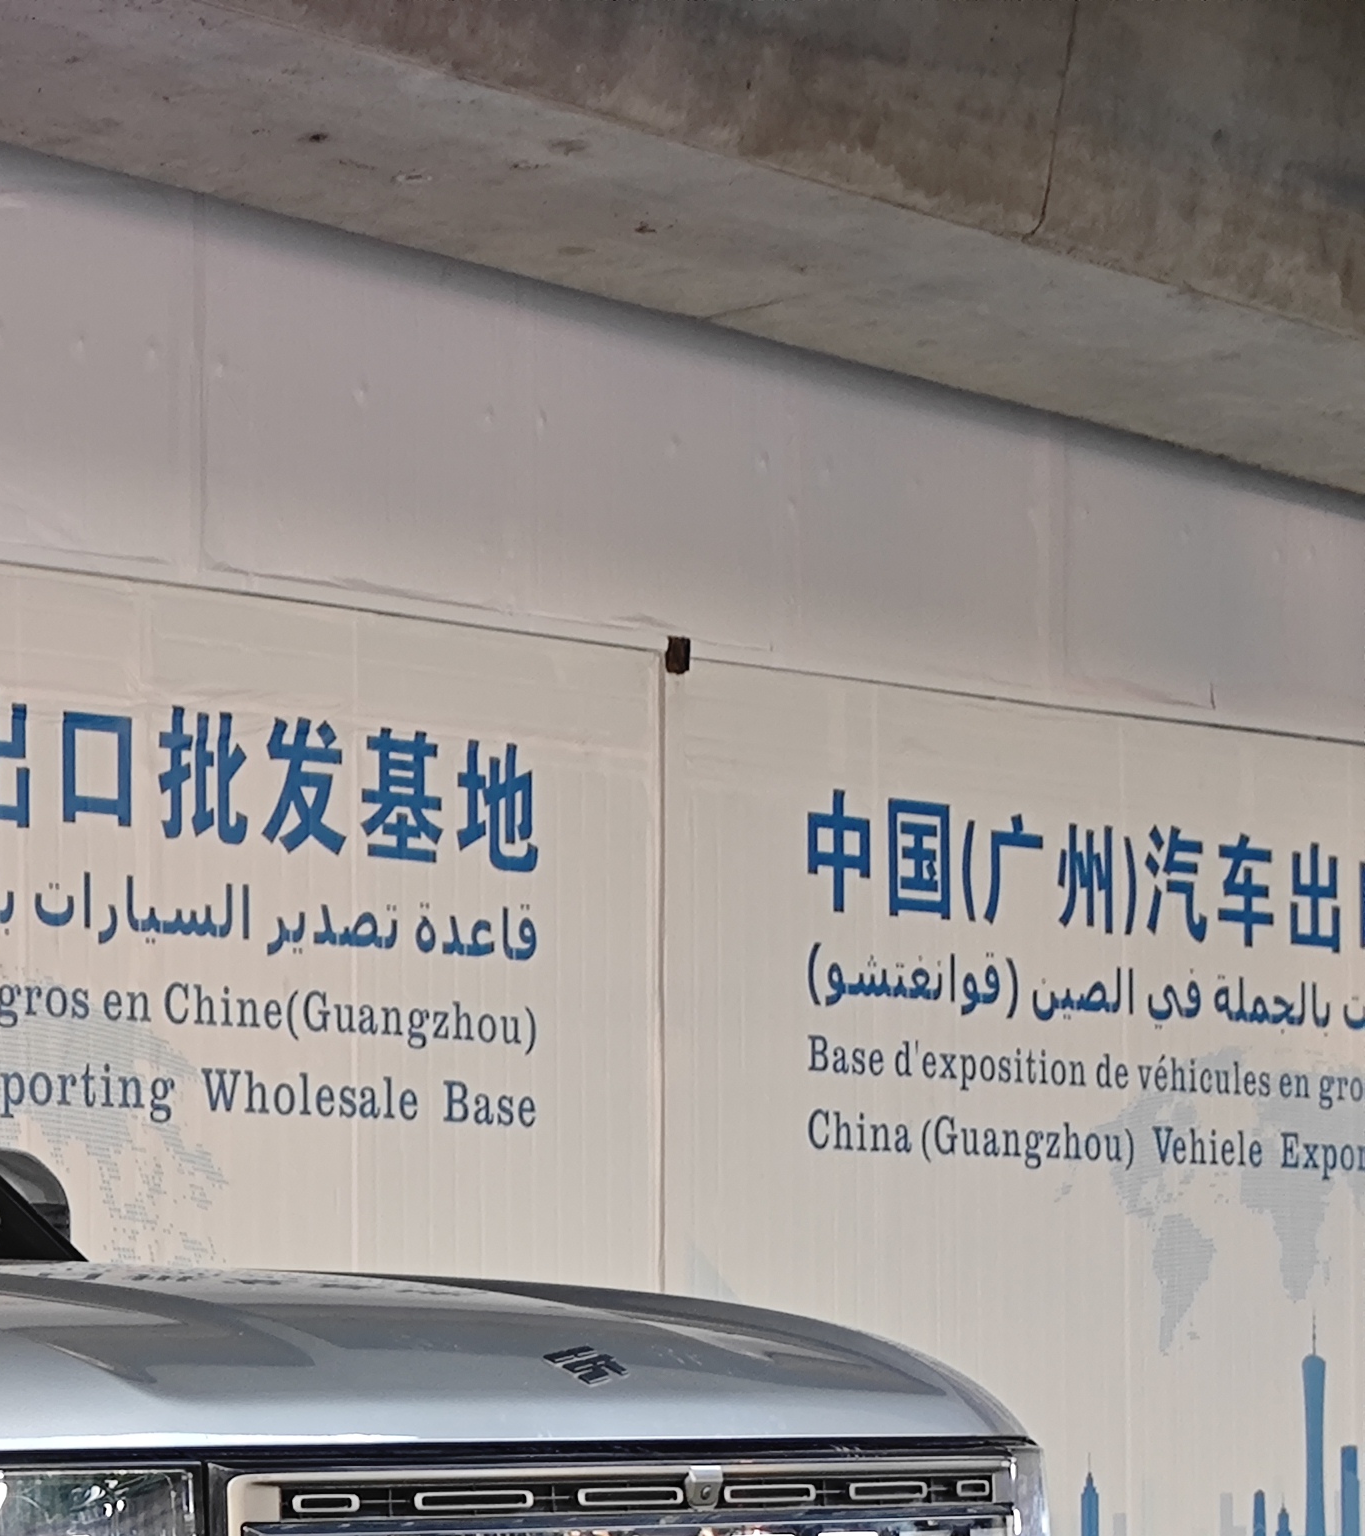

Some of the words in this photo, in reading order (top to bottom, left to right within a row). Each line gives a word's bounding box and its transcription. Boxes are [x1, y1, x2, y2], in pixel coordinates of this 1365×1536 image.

[806, 788, 1365, 954] 中国(广州)汽车出
[33, 871, 251, 946] السيارات
[266, 902, 399, 957] تصدير
[415, 901, 538, 961] قاعدة
[103, 988, 152, 1023] en
[163, 981, 537, 1056] Chine(Guangzhou)
[1032, 966, 1134, 1022] الصين
[1147, 967, 1202, 1031] في
[1213, 973, 1331, 1037] بالجملة
[200, 1067, 418, 1121] Wholesale
[442, 1079, 537, 1128] Base
[807, 1034, 885, 1077] Base
[894, 1039, 1087, 1092] d'exposition
[1096, 1053, 1129, 1089] de
[1137, 1053, 1271, 1098] véhicules
[1279, 1071, 1310, 1099] en
[807, 1108, 912, 1153] China
[921, 1114, 1135, 1171] (Guangzhou)
[1151, 1125, 1263, 1168] Vehiele
